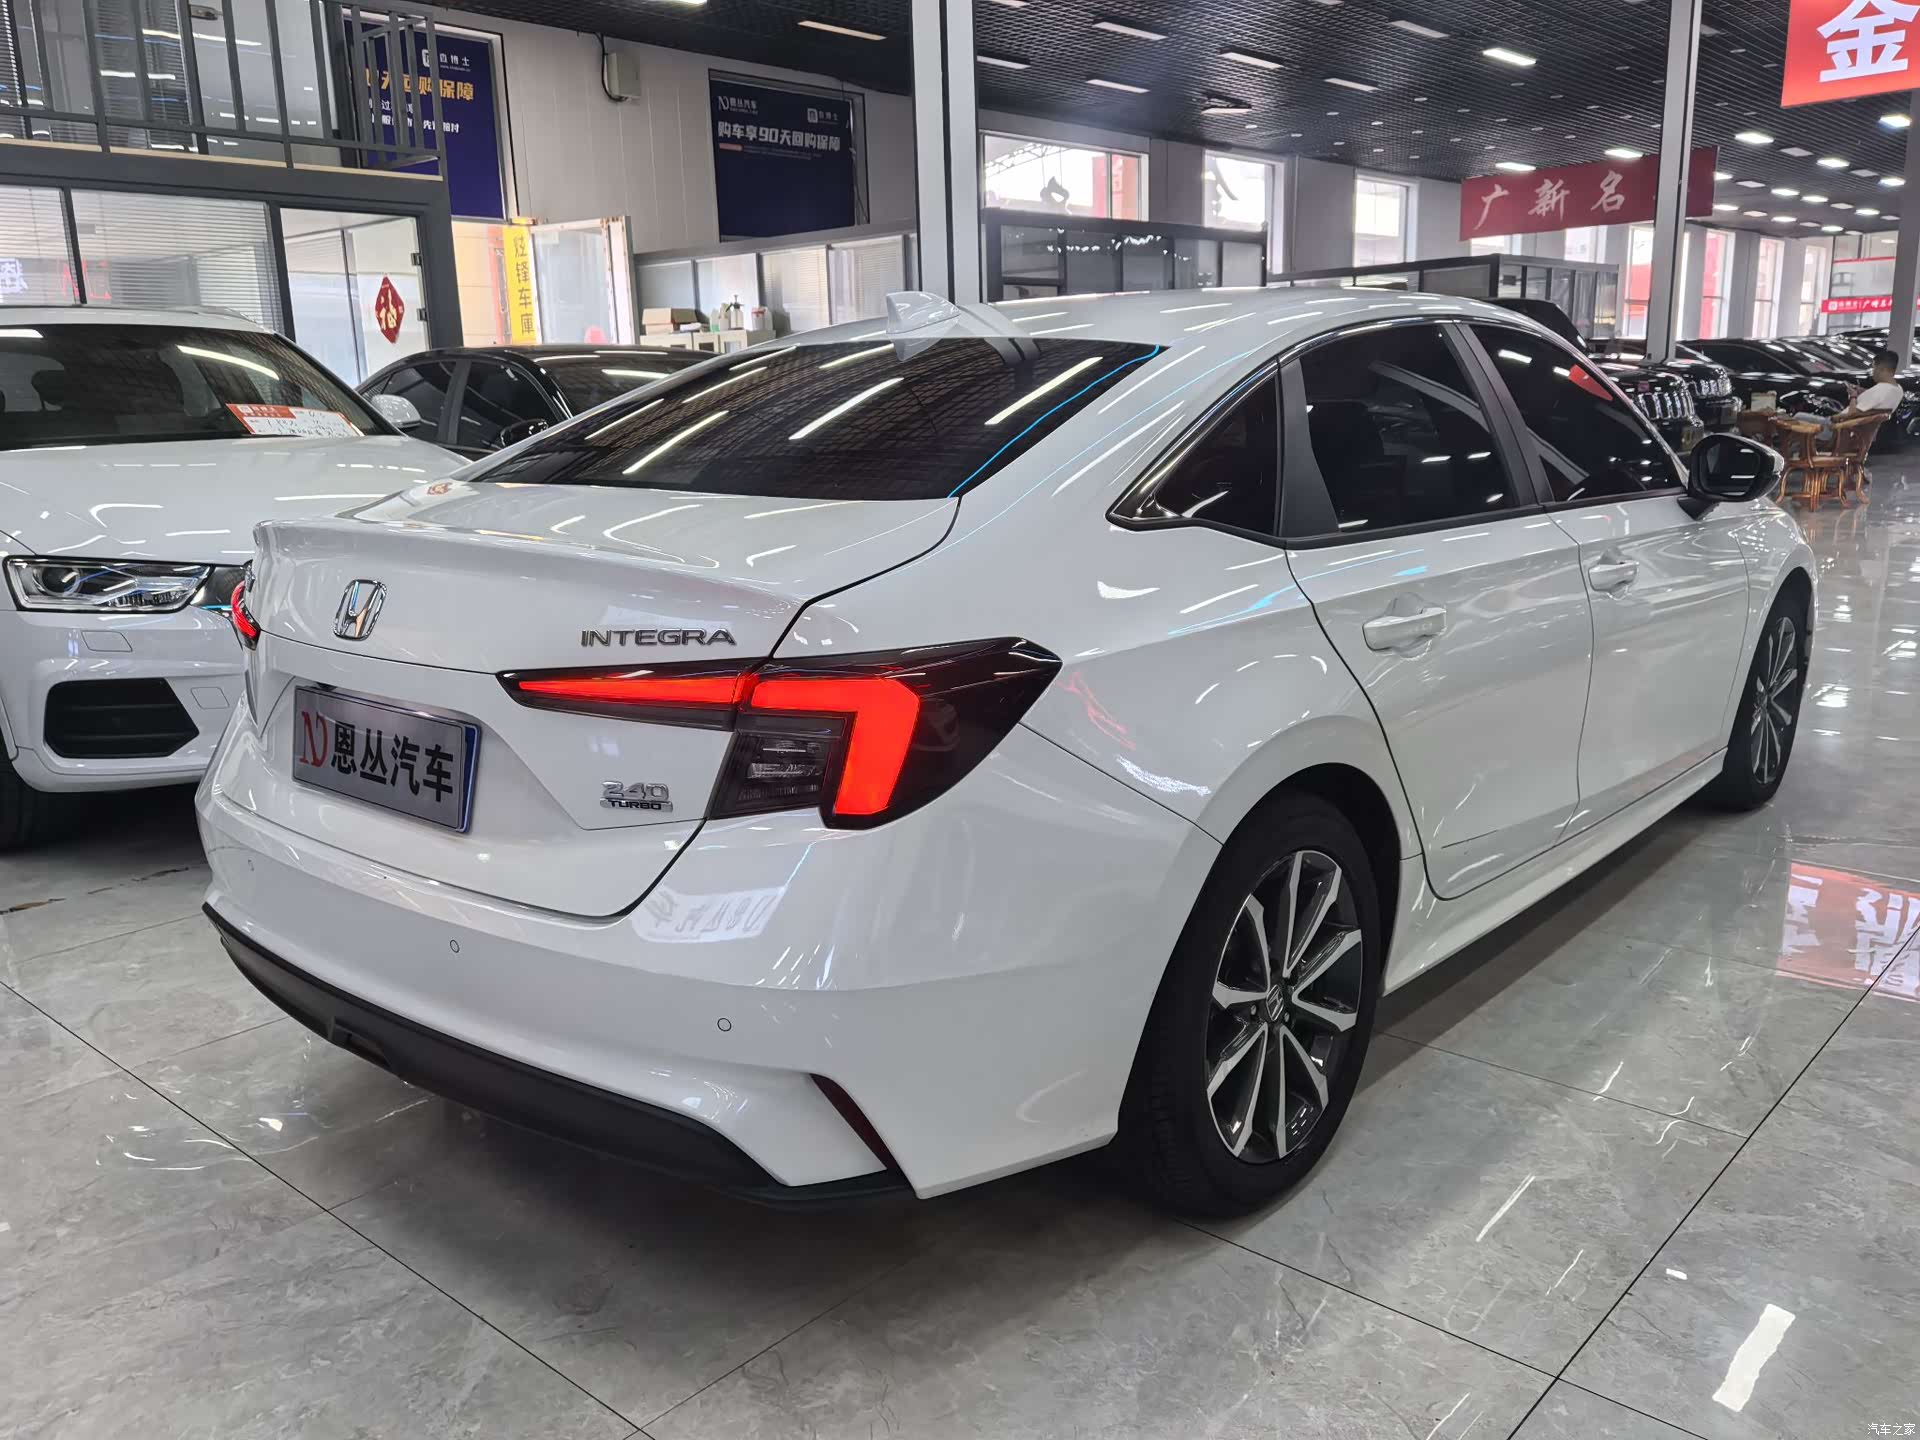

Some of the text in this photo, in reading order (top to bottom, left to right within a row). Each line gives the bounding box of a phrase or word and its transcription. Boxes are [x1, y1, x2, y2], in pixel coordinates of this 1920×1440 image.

[1816, 0, 1920, 83] 金
[717, 121, 841, 152] 购车享90天回购保障
[1473, 169, 1627, 231] 广新名
[581, 629, 737, 647] INTEGRA
[330, 720, 454, 803] 恩丛汽车
[602, 780, 669, 801] 240
[609, 799, 662, 810] TURBO
